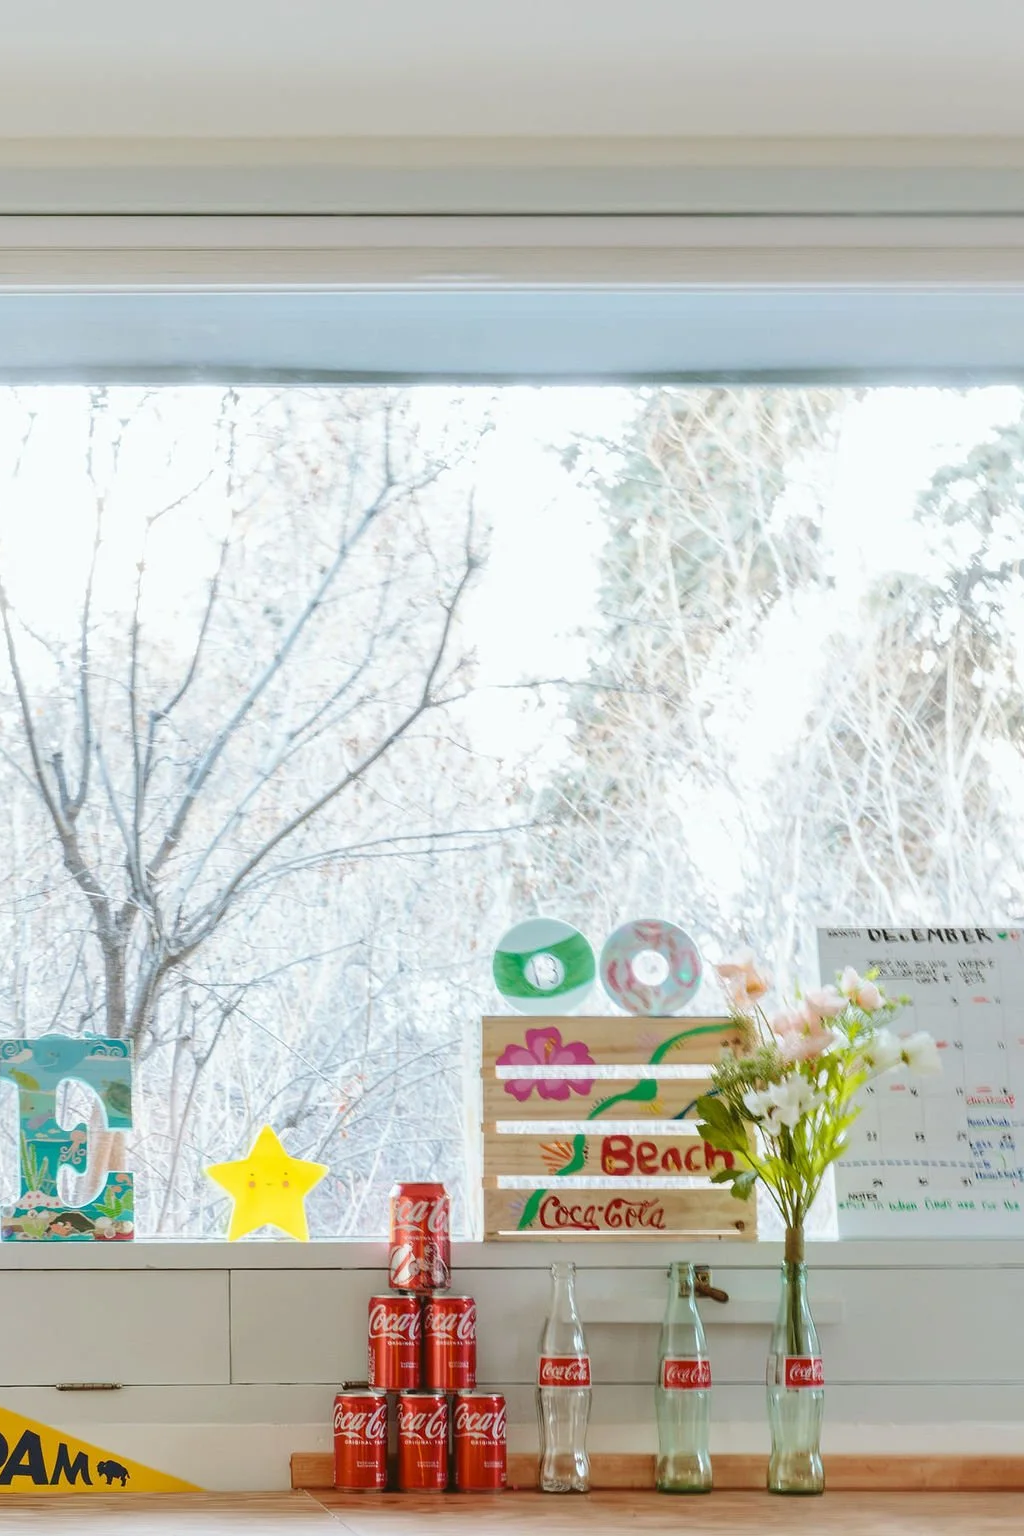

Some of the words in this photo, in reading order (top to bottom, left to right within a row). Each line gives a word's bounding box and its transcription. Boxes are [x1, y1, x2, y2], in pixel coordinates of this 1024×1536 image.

[867, 928, 993, 944] DECEMBER
[600, 1135, 735, 1176] Beach
[539, 1196, 666, 1231] Coca-Cola
[542, 1361, 587, 1381] Coca-Cola
